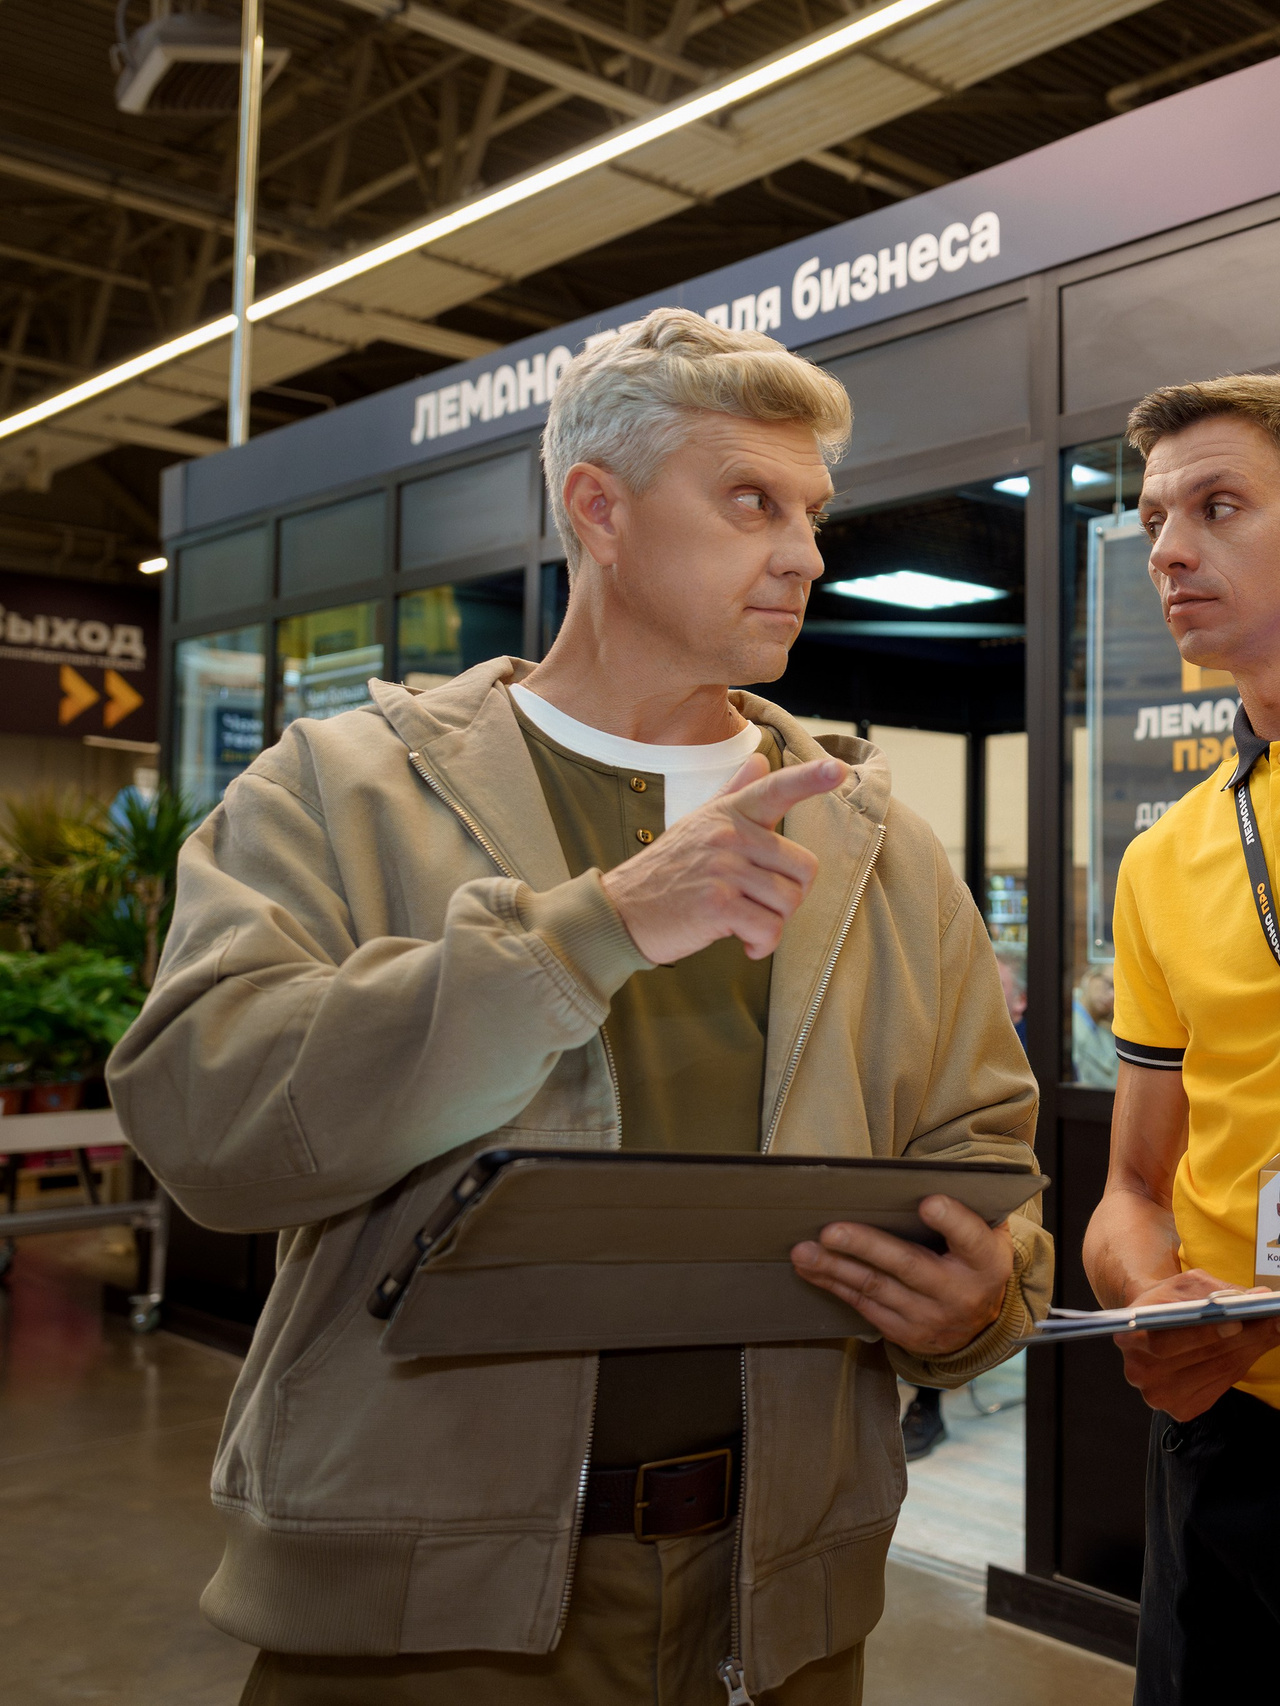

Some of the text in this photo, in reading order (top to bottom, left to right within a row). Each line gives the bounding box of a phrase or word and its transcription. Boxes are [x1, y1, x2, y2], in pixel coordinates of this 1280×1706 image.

[791, 211, 1000, 320] бизнеса
[0, 602, 147, 660] ыход
[1134, 697, 1242, 741] ЛЕМА
[1237, 786, 1255, 845] ЛЕМАНА
[1256, 883, 1270, 915] ПРО
